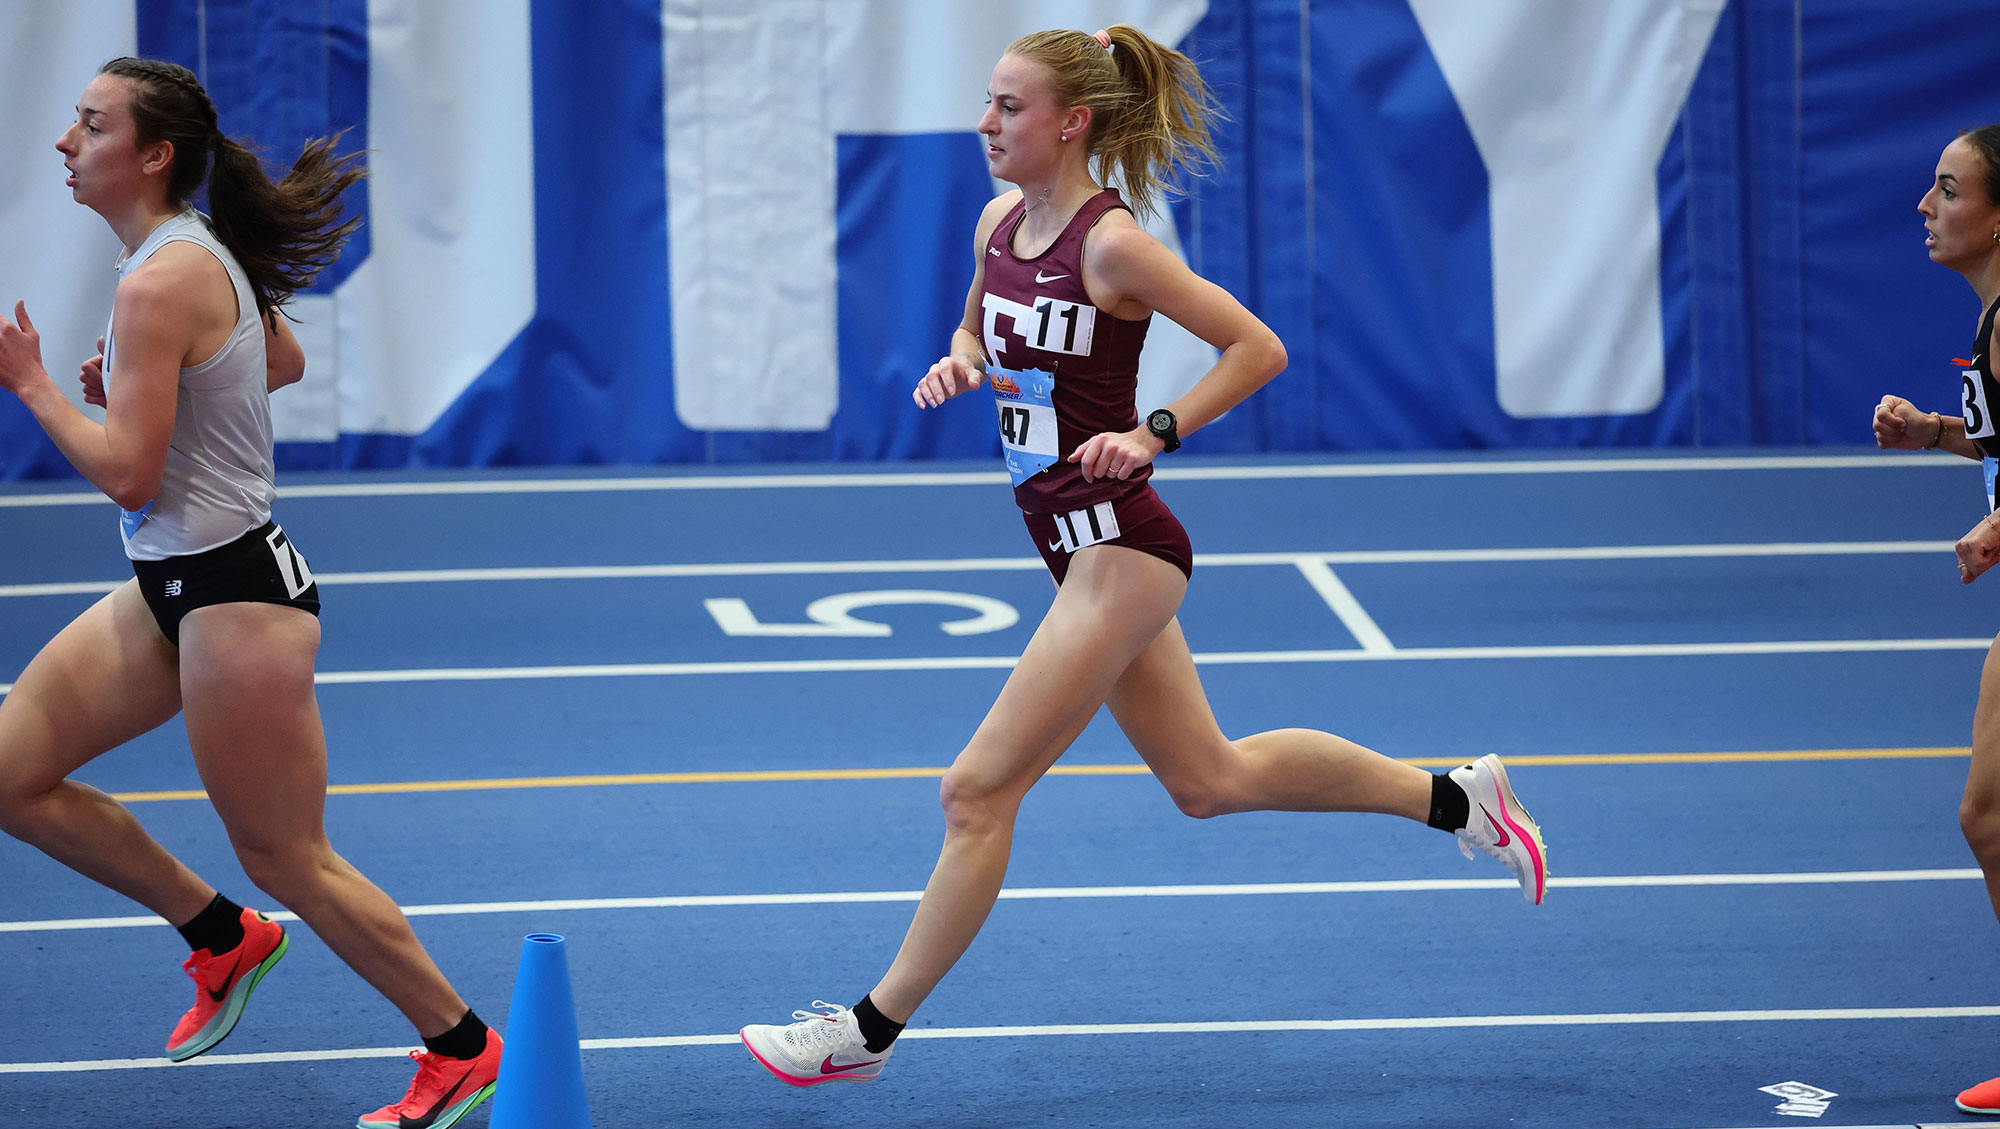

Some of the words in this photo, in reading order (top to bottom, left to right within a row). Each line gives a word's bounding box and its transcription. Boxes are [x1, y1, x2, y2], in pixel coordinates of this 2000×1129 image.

[1036, 300, 1079, 352] 11
[998, 406, 1030, 446] 47
[1962, 375, 1983, 435] 3
[1057, 506, 1103, 548] 11
[272, 530, 305, 590] 7
[702, 589, 1020, 638] 5
